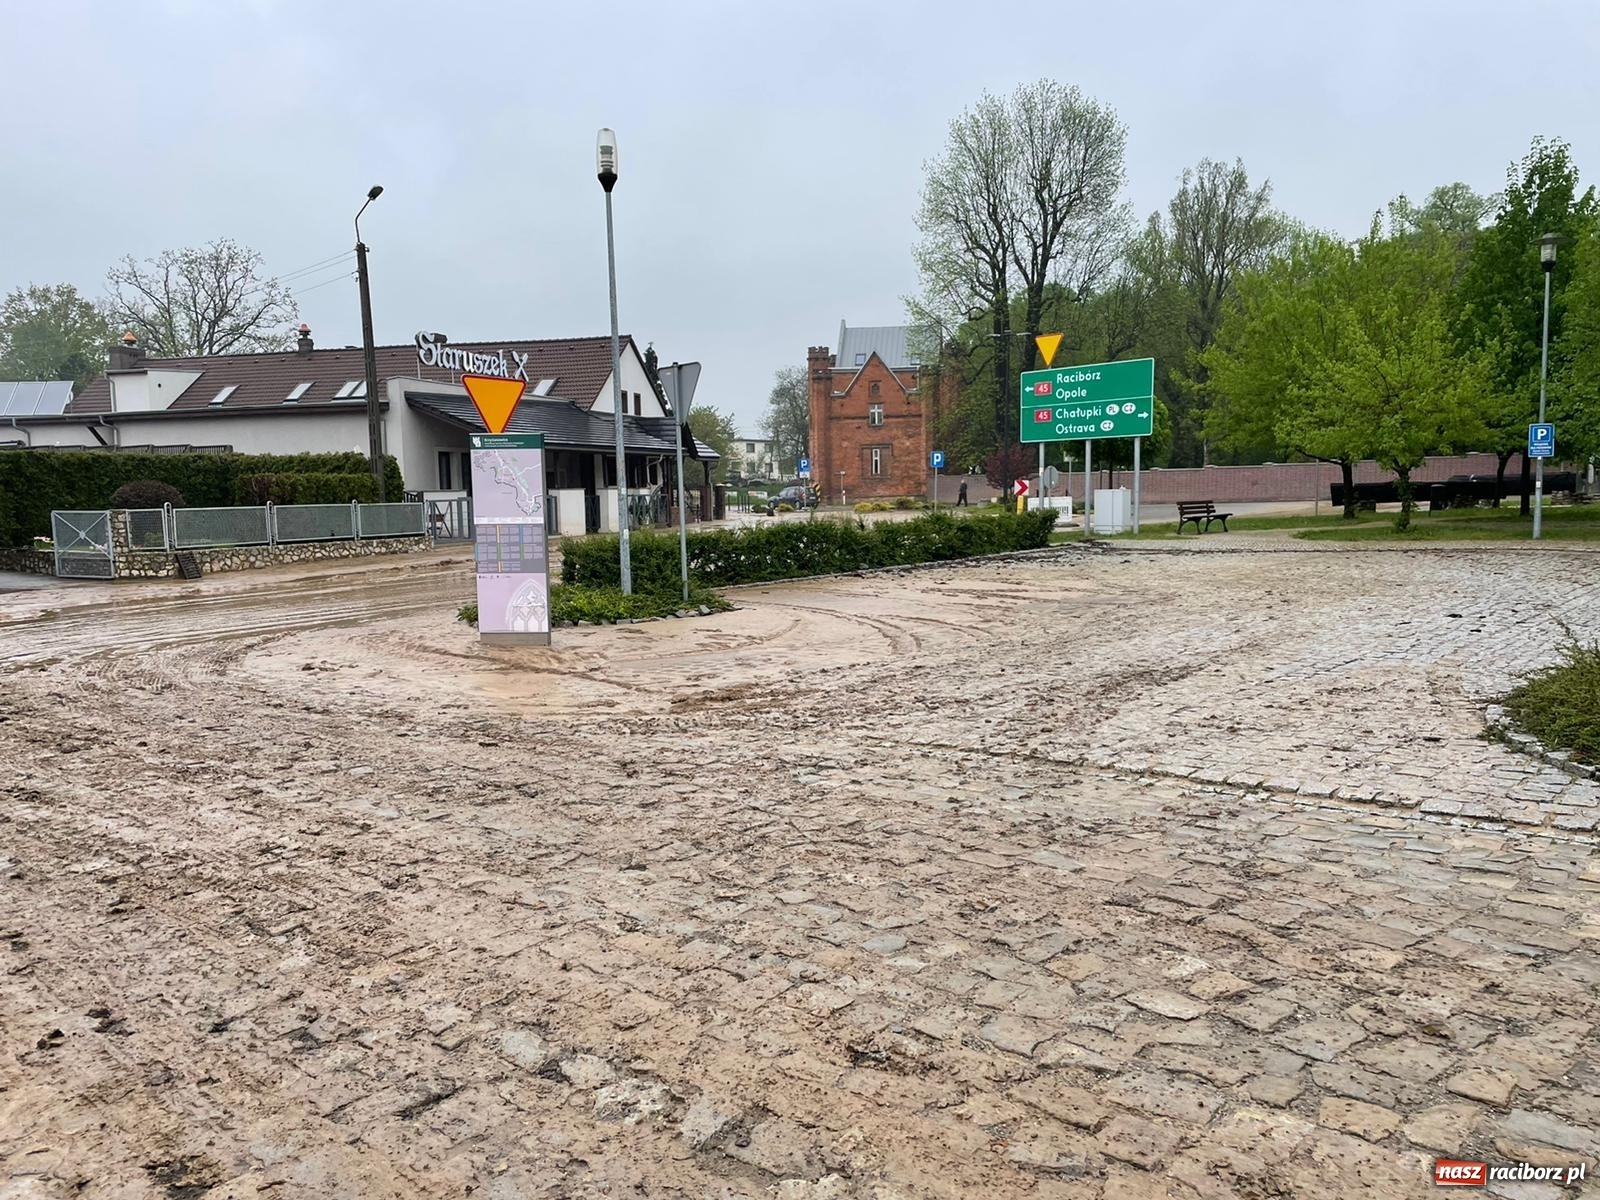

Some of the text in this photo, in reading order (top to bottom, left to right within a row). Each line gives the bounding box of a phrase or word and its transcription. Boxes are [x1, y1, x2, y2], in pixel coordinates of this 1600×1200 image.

[417, 331, 508, 378] Staruszek
[1056, 370, 1101, 384] Racibórz
[1038, 383, 1048, 393] 45
[1055, 387, 1087, 401] Opole
[1038, 404, 1133, 420] 45 Chałupki PL CZ
[1055, 421, 1112, 434] Ostrava CZ
[1537, 428, 1548, 440] P
[800, 459, 808, 469] P
[933, 453, 942, 466] P
